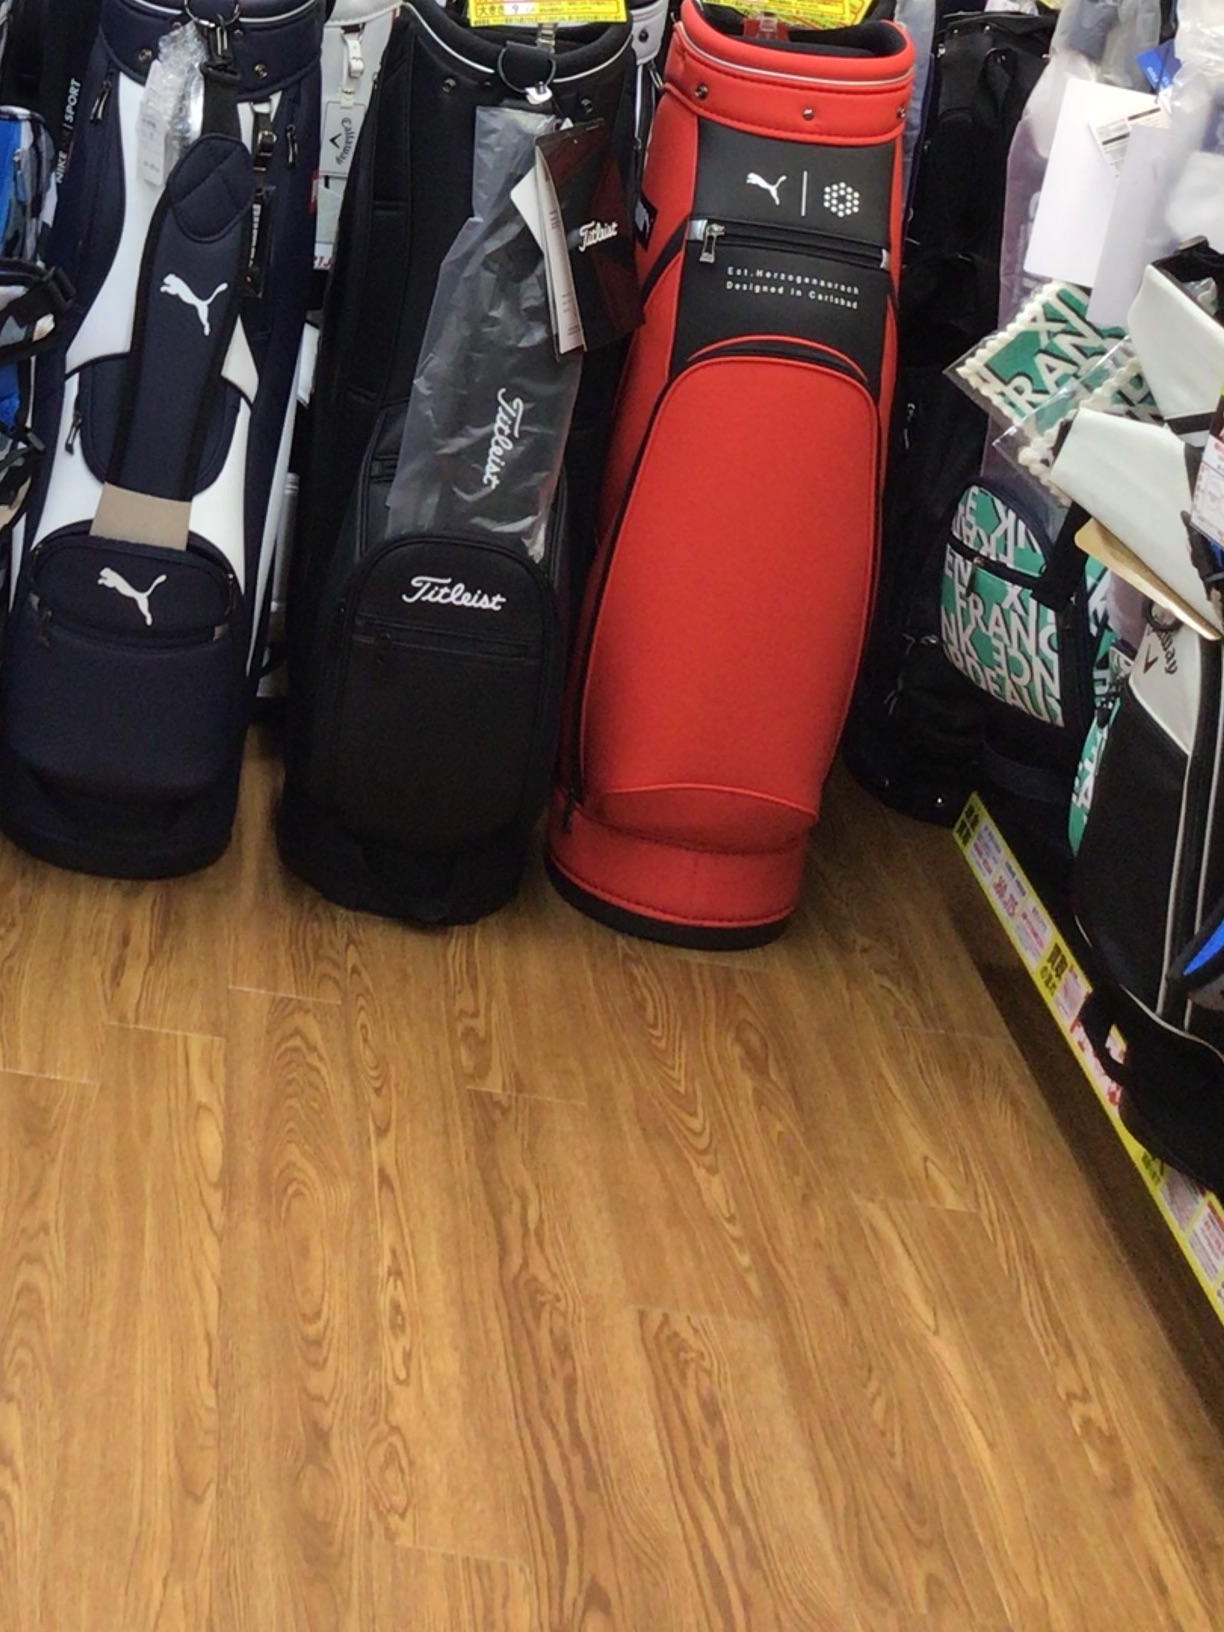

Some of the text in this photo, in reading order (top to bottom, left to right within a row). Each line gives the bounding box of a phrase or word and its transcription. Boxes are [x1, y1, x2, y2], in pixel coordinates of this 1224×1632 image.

[54, 77, 83, 184] NIKE SPORT
[578, 220, 619, 253] Titleist
[726, 280, 785, 295] Designed
[808, 290, 859, 310] Carlsbad
[479, 388, 525, 490] Titleist
[402, 574, 506, 613] Titleist
